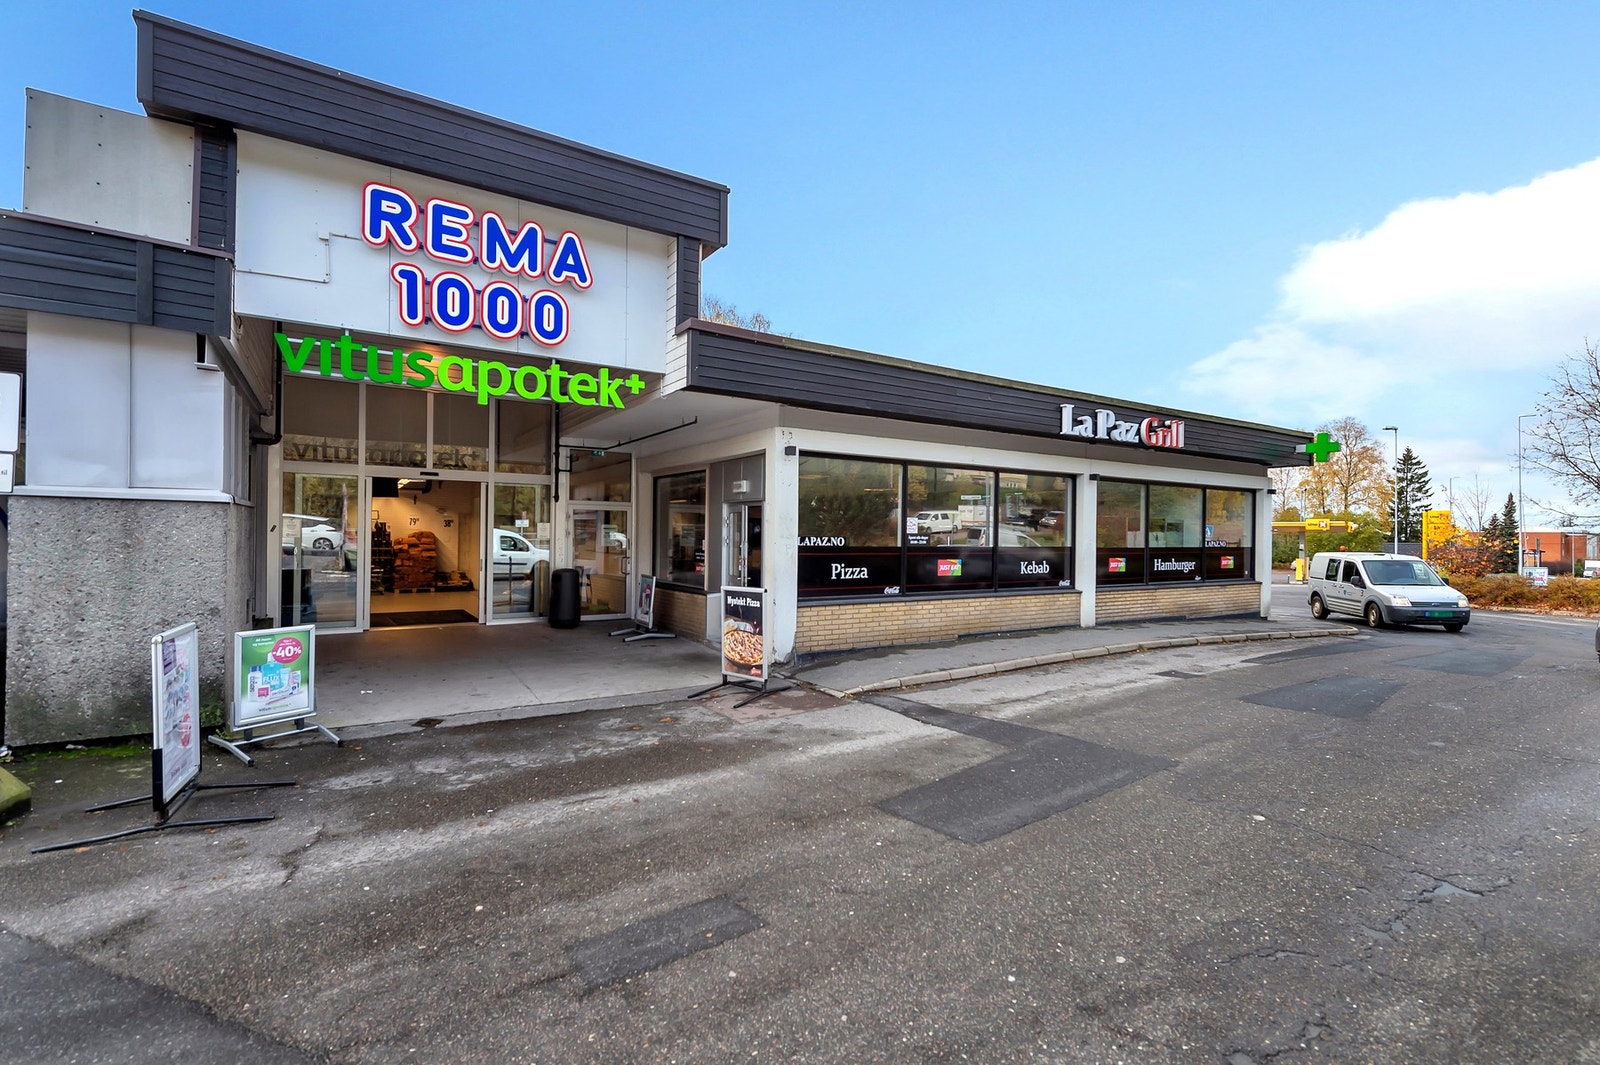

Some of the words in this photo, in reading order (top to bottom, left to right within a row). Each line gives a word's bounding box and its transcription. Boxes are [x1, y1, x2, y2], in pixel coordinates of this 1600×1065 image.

[361, 181, 593, 290] REMA
[390, 262, 570, 346] 1000
[1140, 416, 1185, 449] Grill
[797, 536, 846, 547] LAPAZ.NO
[831, 563, 868, 580] Pizza
[1020, 561, 1050, 575] Kebab
[1153, 558, 1196, 573] Hamburger
[746, 597, 760, 607] Pizza
[272, 646, 302, 658] -40%
